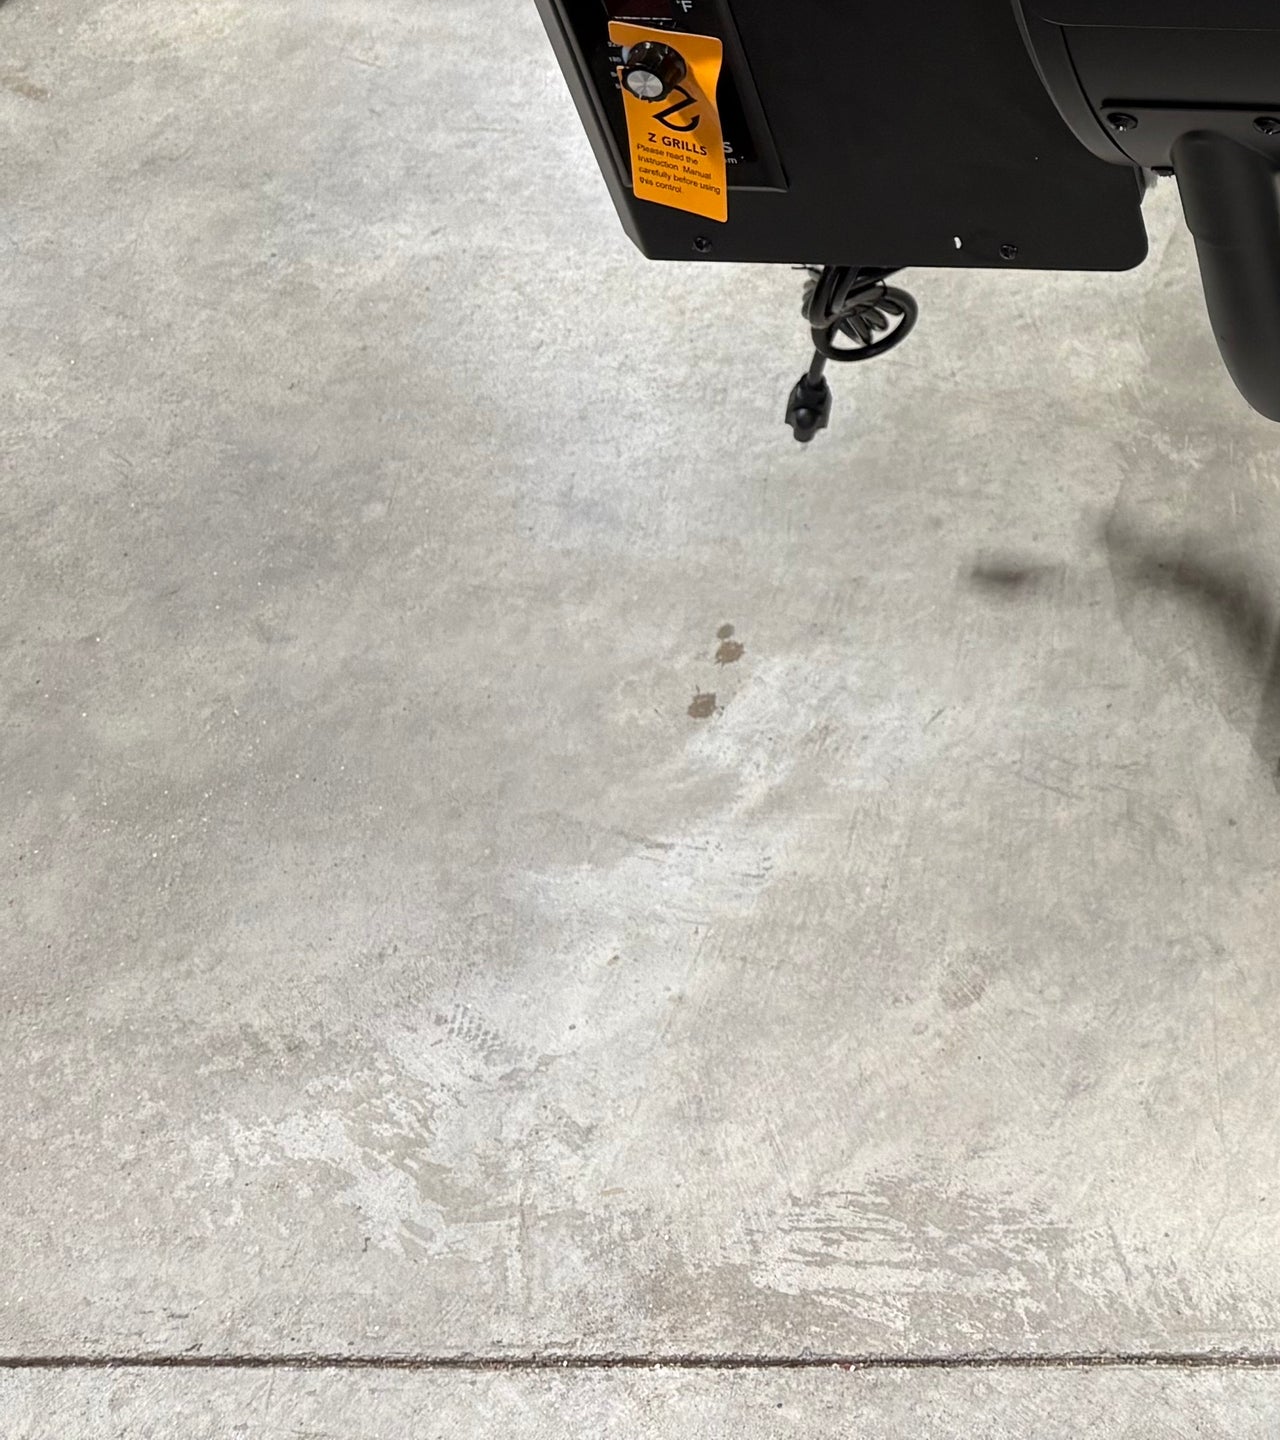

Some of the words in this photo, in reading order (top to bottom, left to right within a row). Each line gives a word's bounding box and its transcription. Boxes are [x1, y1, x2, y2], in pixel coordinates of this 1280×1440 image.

[637, 143, 665, 157] Please
[666, 151, 684, 161] read
[686, 156, 698, 165] the
[648, 132, 657, 143] Z
[661, 136, 707, 156] GRILLS
[638, 155, 679, 171] Instruction
[683, 166, 711, 180] Manual
[639, 167, 671, 181] carefully
[674, 174, 698, 187] before
[700, 183, 720, 195] using
[640, 177, 653, 186] this
